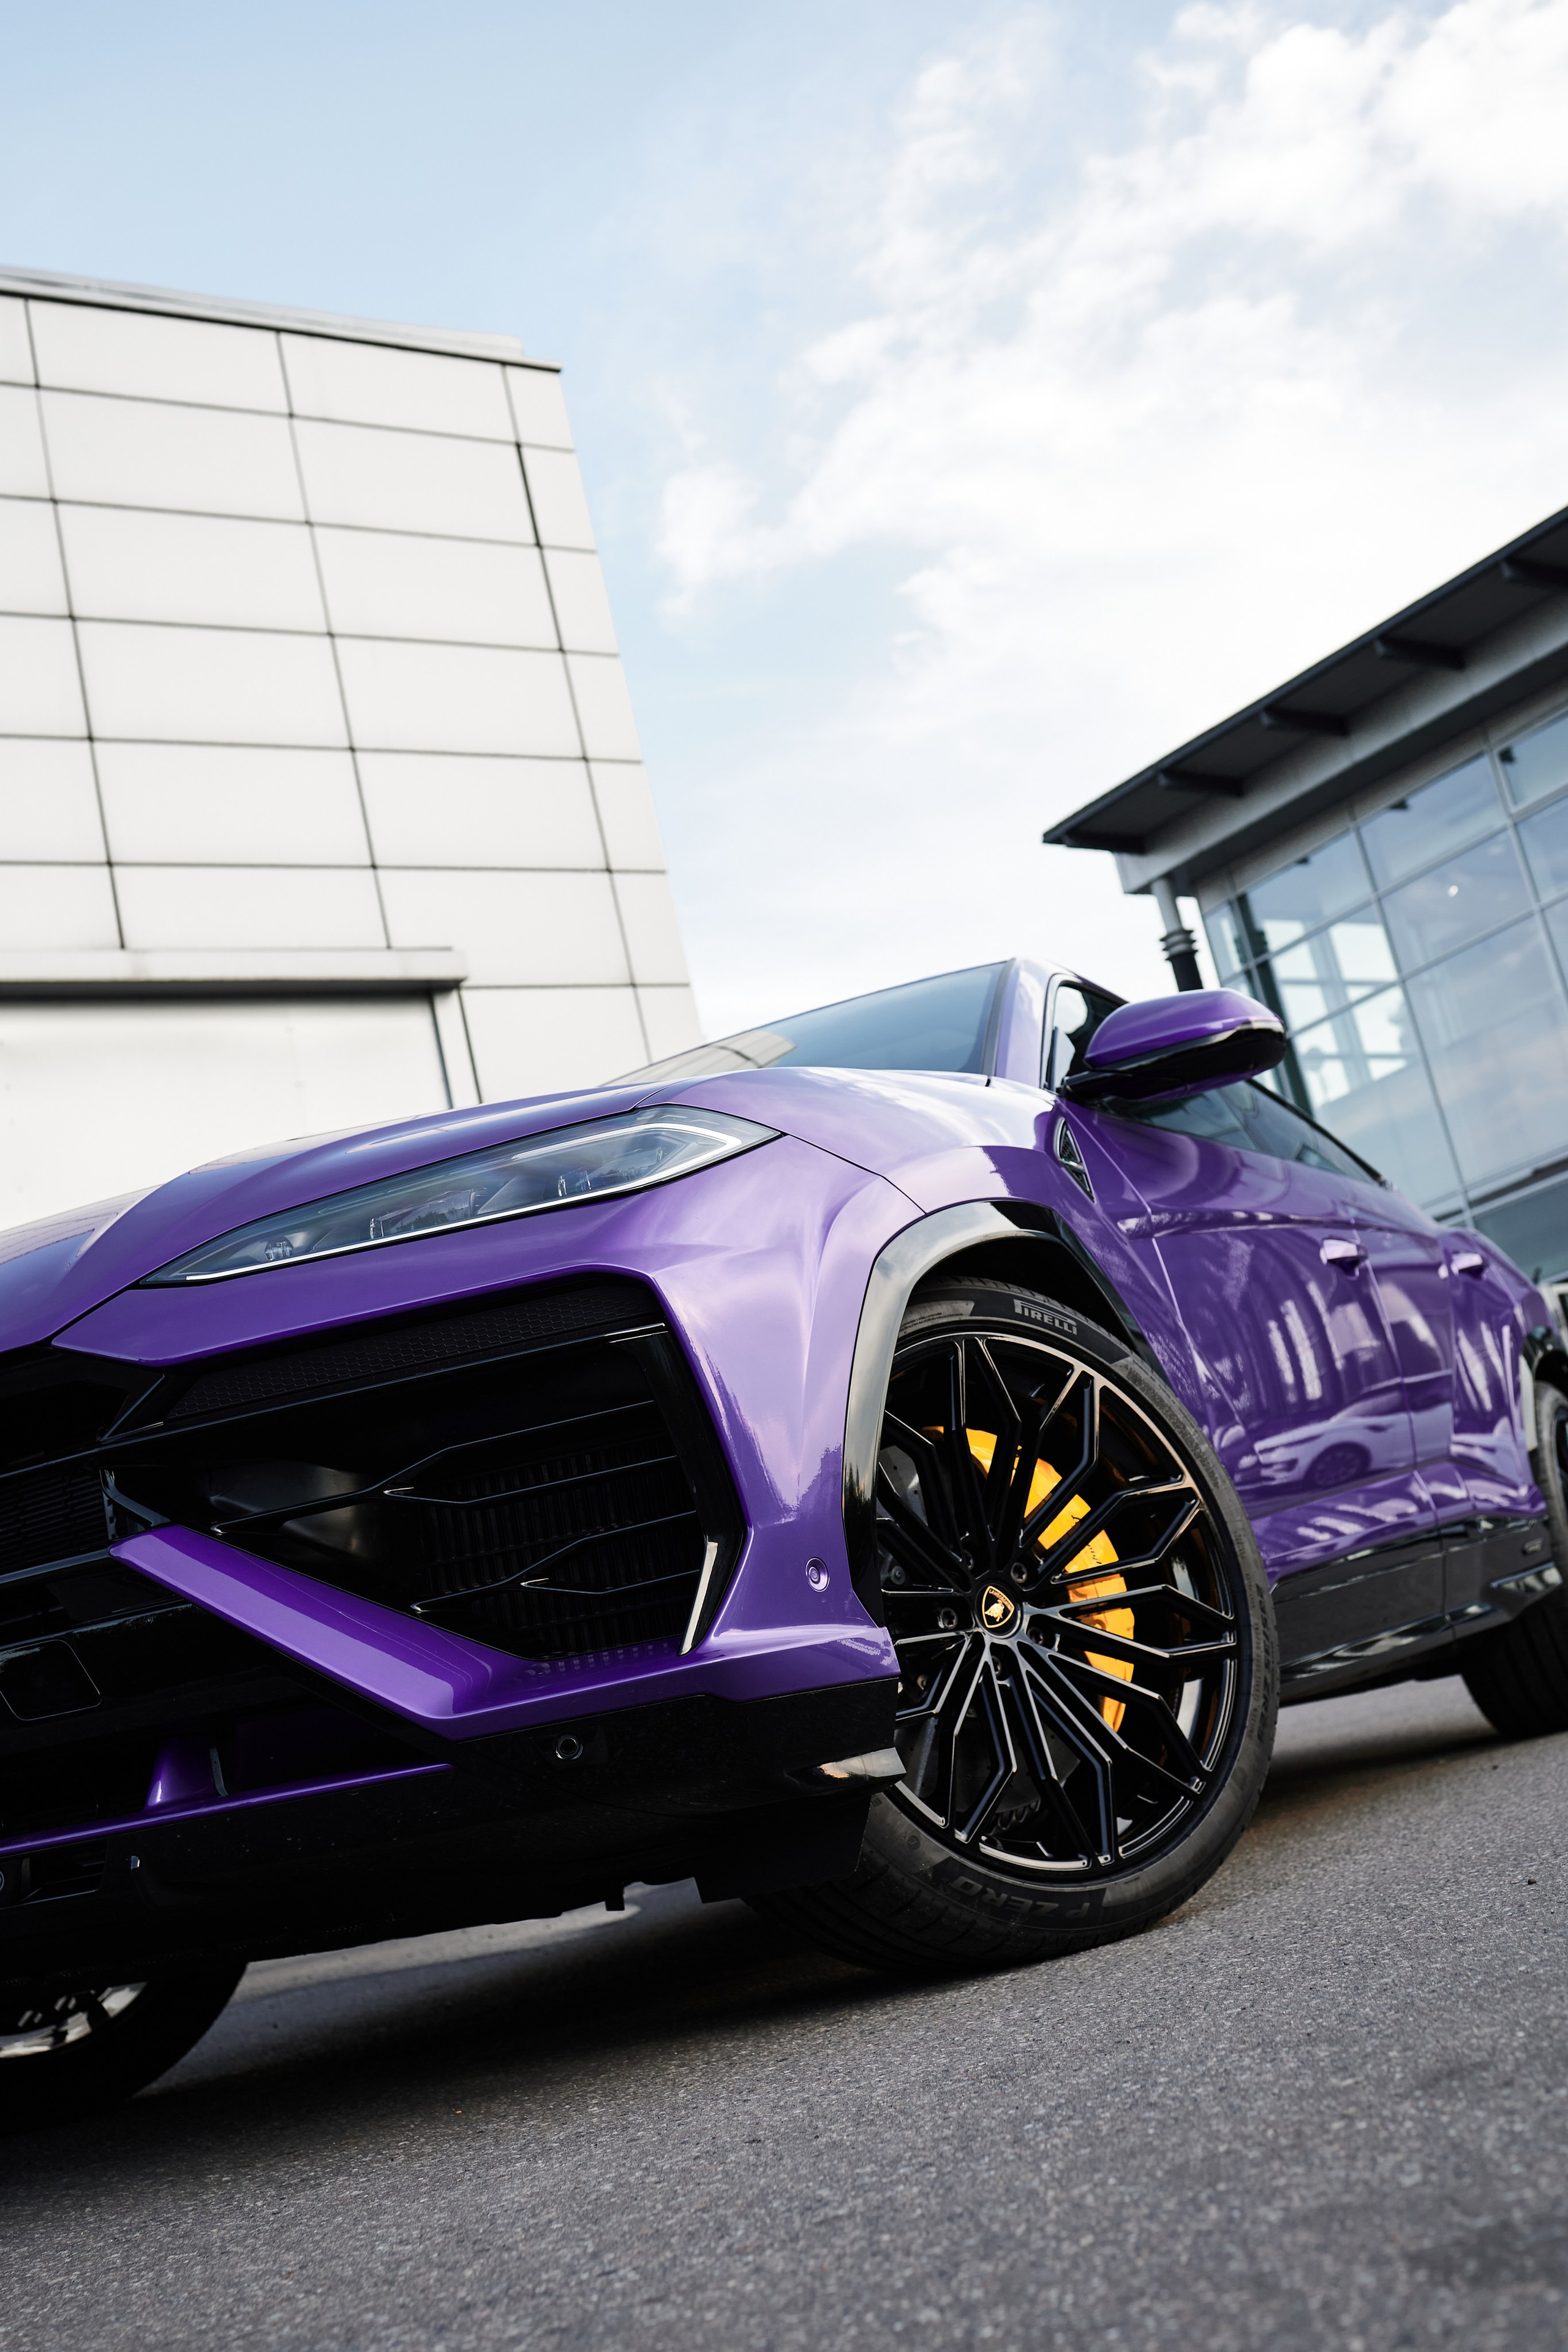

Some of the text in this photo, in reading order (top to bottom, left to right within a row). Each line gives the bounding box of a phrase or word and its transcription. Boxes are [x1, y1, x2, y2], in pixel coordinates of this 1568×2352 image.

[1013, 1298, 1077, 1335] PIRELLI
[950, 1875, 1090, 1918] P ZERO
